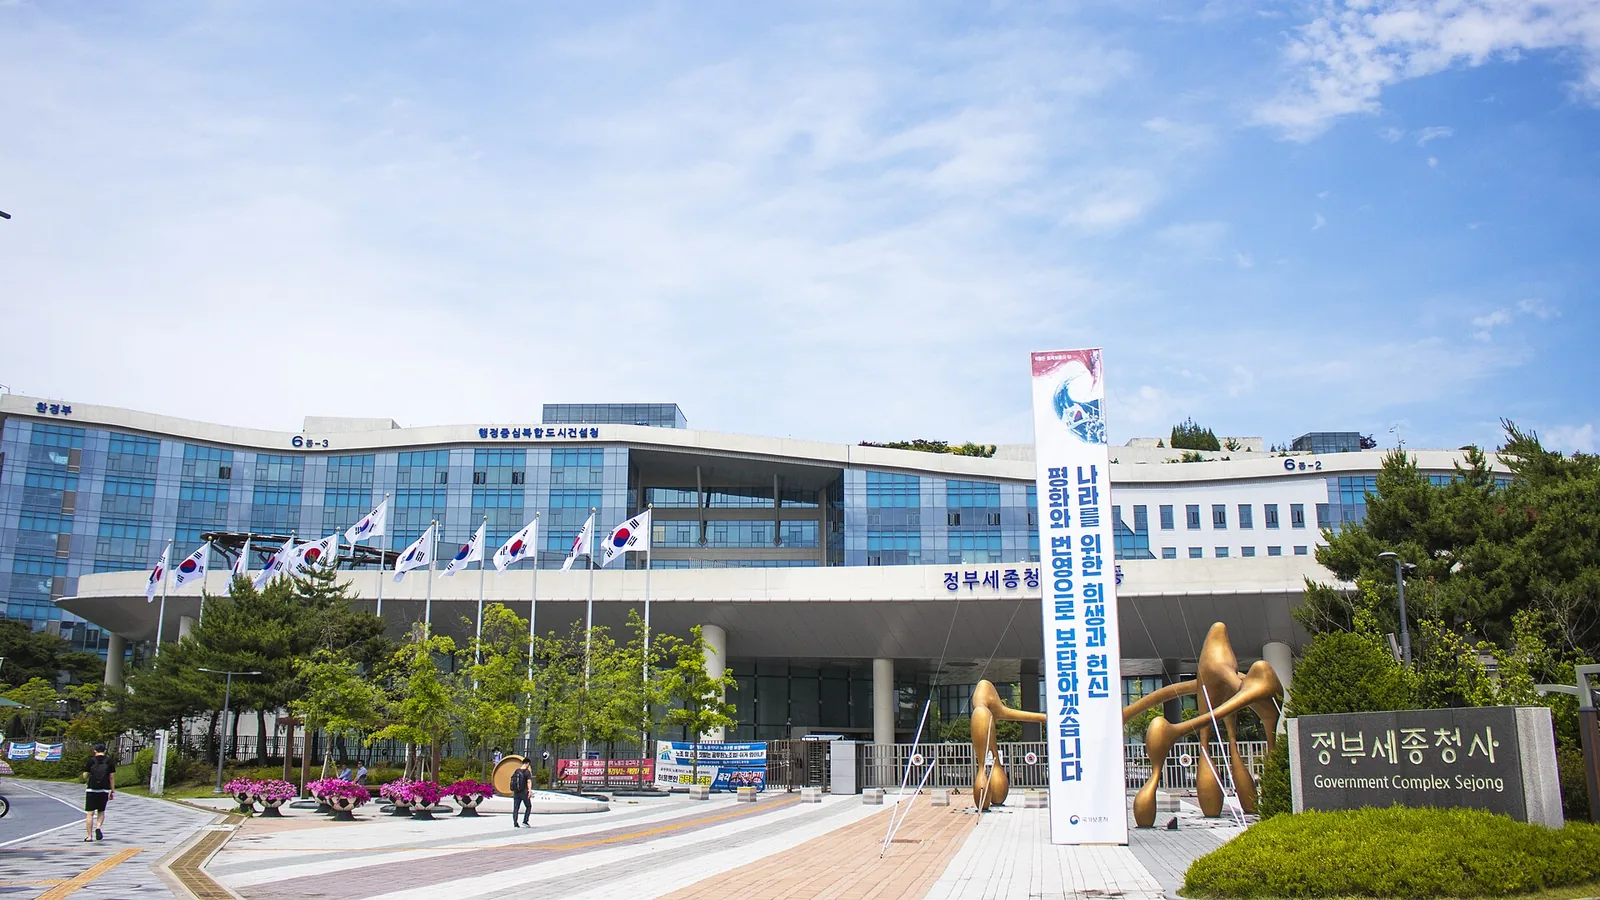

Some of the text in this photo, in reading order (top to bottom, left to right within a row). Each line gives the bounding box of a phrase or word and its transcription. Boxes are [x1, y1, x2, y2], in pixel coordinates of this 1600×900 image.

[36, 401, 72, 416] 환경부
[478, 427, 599, 439] 행정중심복합도시건설청
[943, 567, 1039, 591] 정부세종청
[1077, 464, 1109, 699] 나라를 위한 희생과 헌신
[1047, 466, 1083, 782] 평화와 번영으로 보답하겠습니다
[1310, 725, 1500, 766] 정부세종청사
[1314, 774, 1504, 793] Government Complex Sejong
